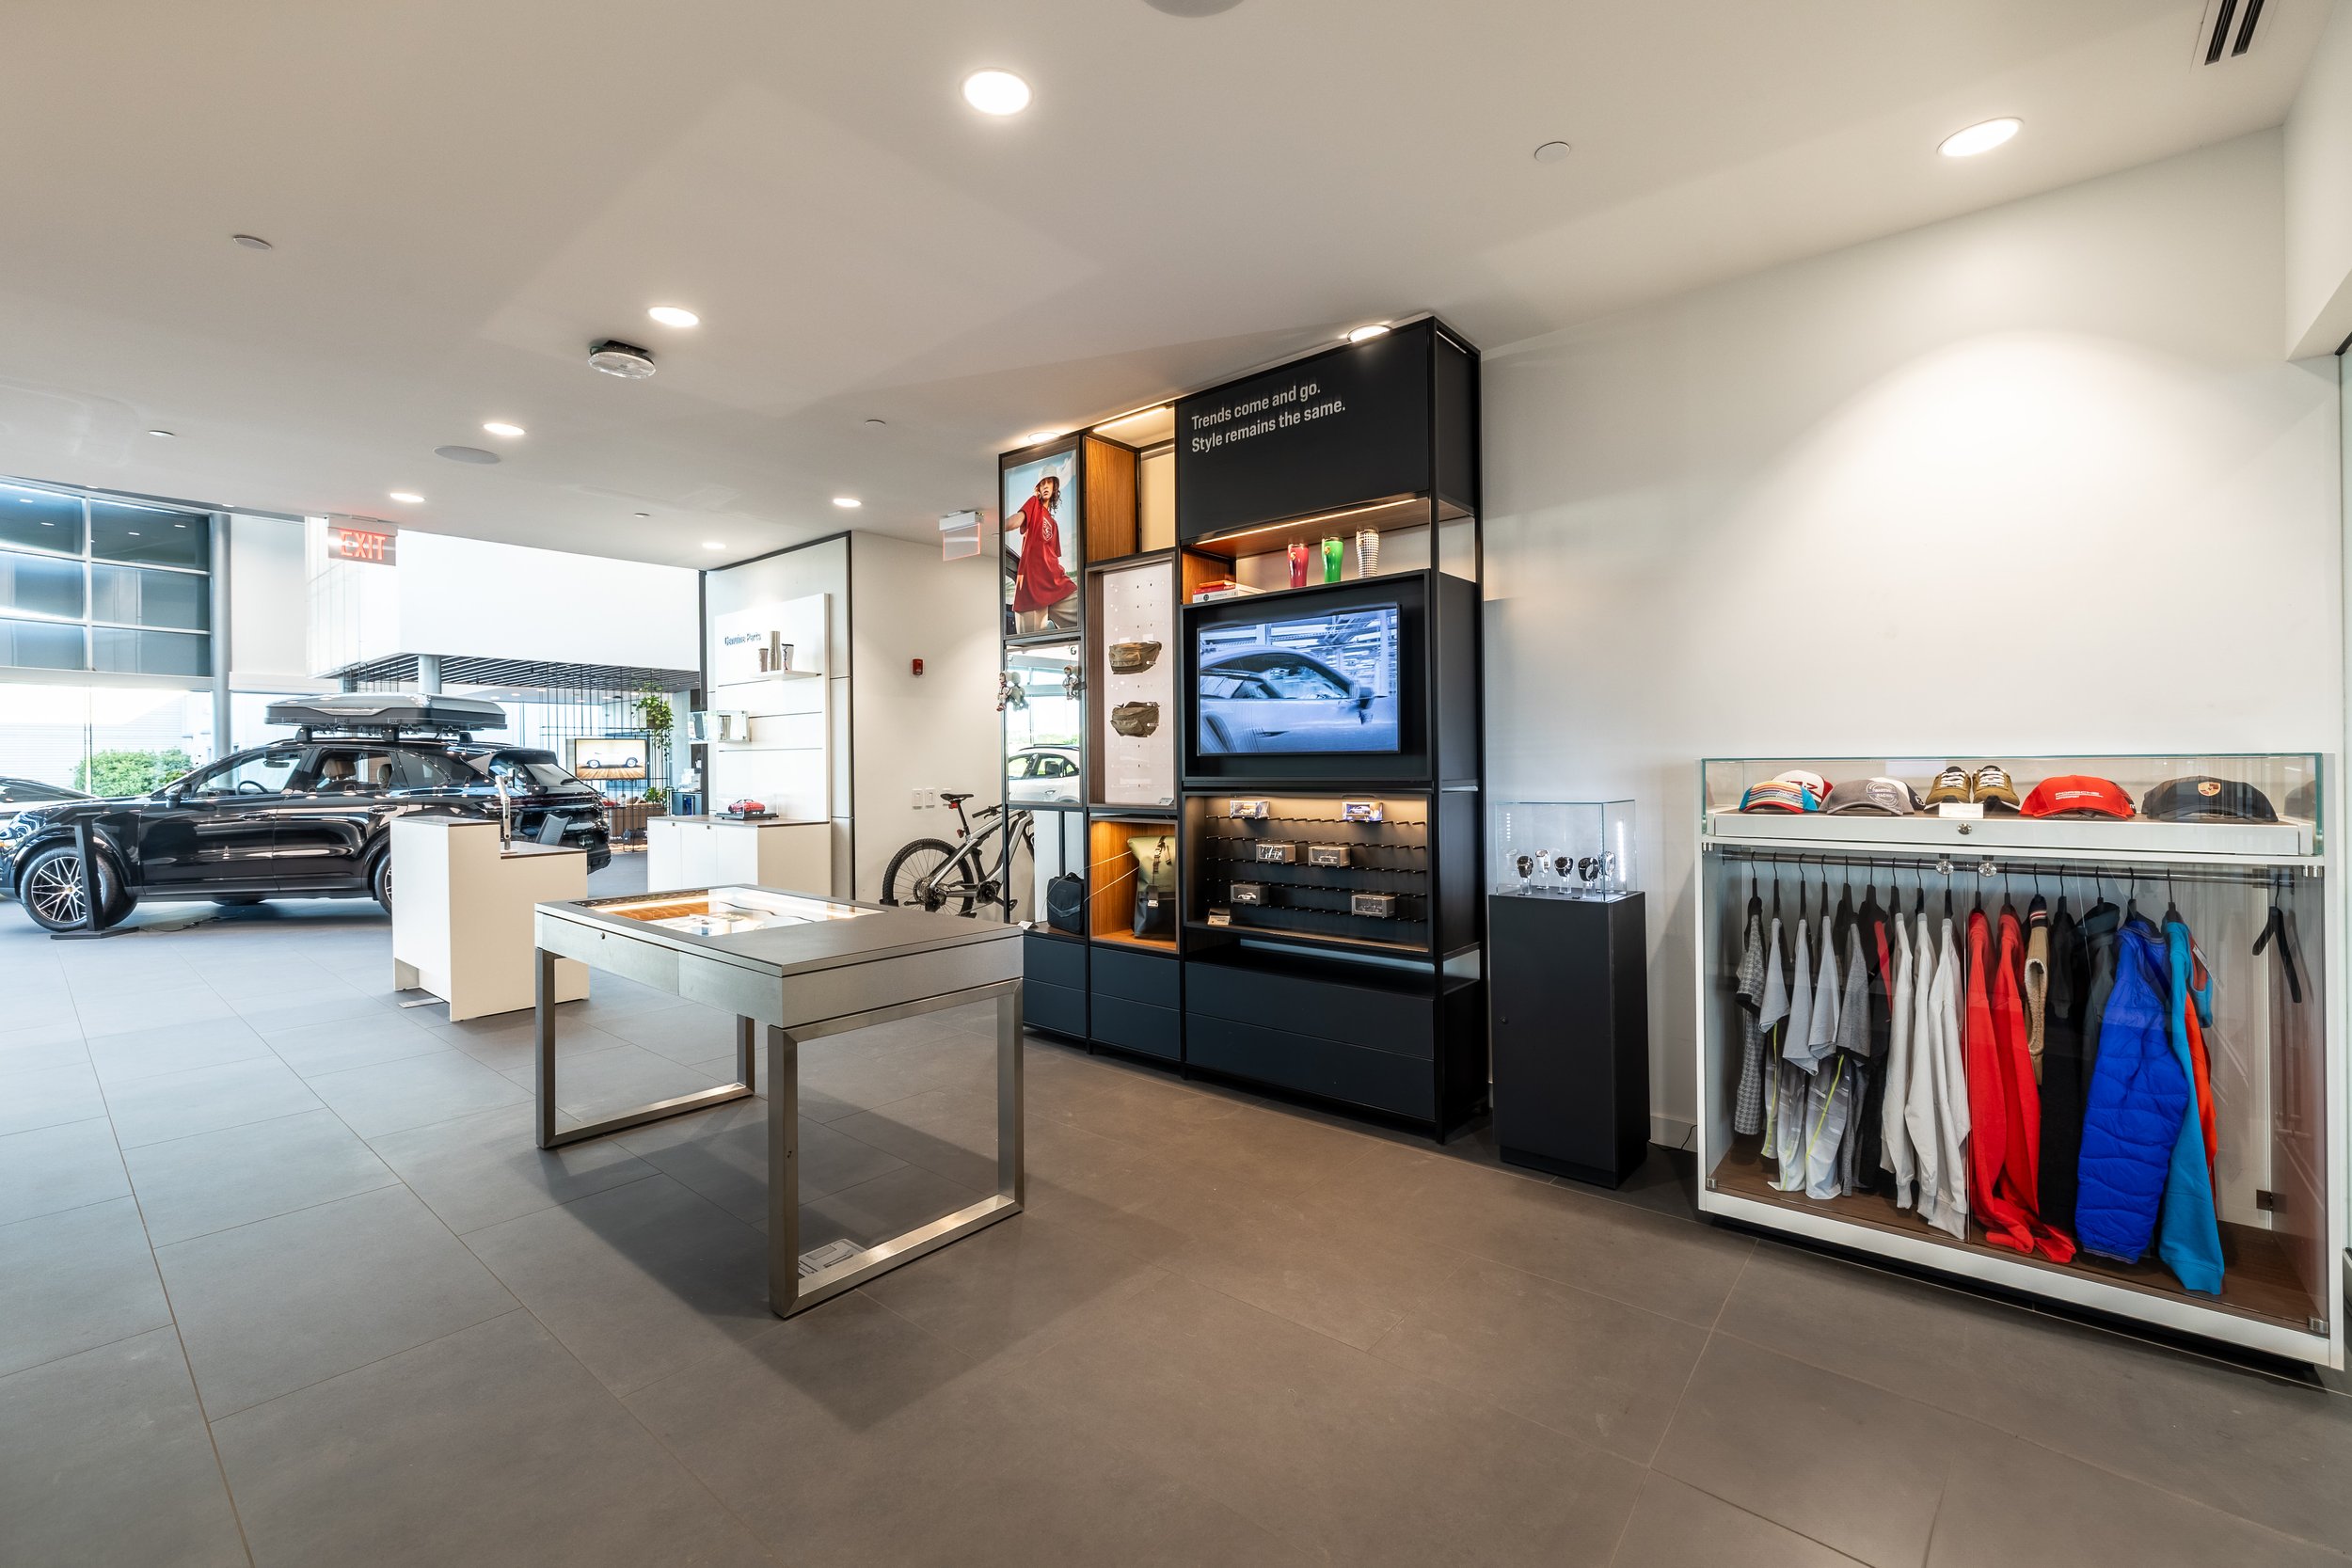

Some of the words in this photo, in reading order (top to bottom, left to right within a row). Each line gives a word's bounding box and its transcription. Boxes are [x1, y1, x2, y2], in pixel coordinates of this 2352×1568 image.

[1191, 407, 1232, 430] Trends
[1234, 398, 1269, 418] come
[1272, 386, 1296, 406] and
[1300, 383, 1321, 403] go.
[1191, 433, 1223, 452] Style
[1225, 420, 1276, 443] remains
[1279, 412, 1301, 428] the
[1304, 400, 1346, 421] same.
[341, 531, 386, 561] EXIT
